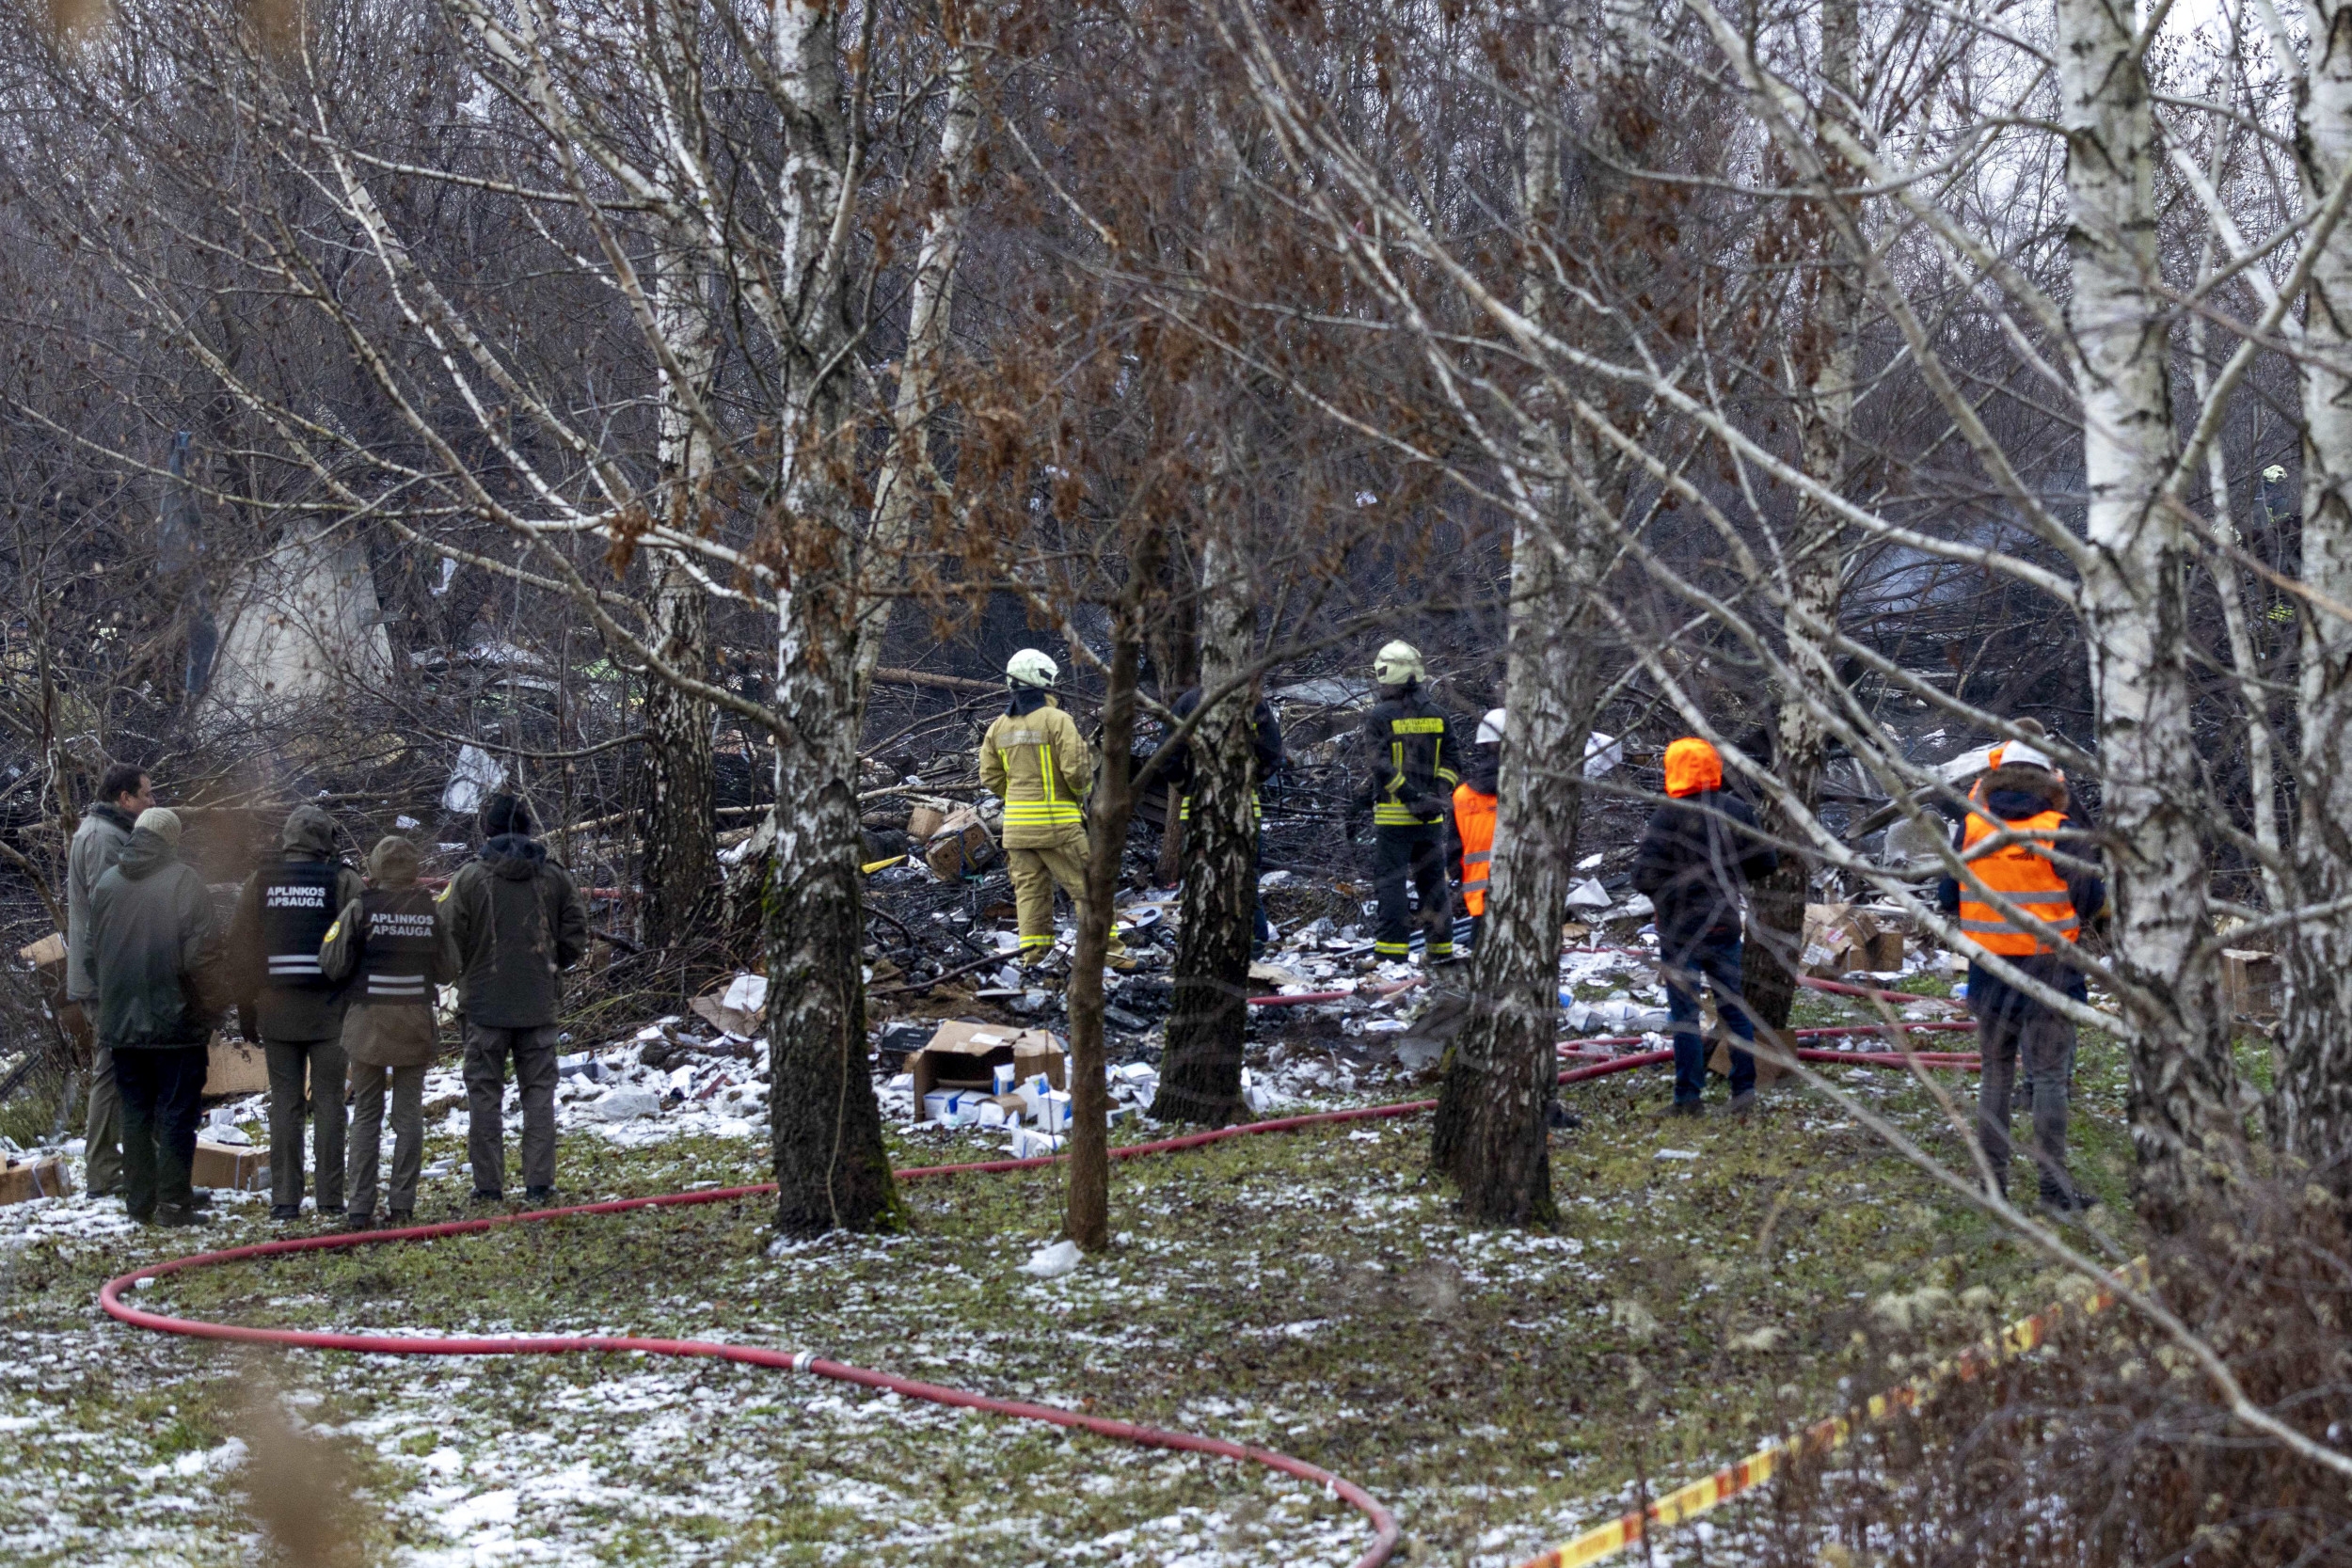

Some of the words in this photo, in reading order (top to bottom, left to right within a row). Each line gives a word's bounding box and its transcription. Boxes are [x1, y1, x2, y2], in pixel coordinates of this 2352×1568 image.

[266, 886, 326, 897] APLINKOS
[267, 896, 325, 908] APSAUGA
[370, 913, 435, 926] APLINKOS
[372, 925, 433, 937] APSAUGA
